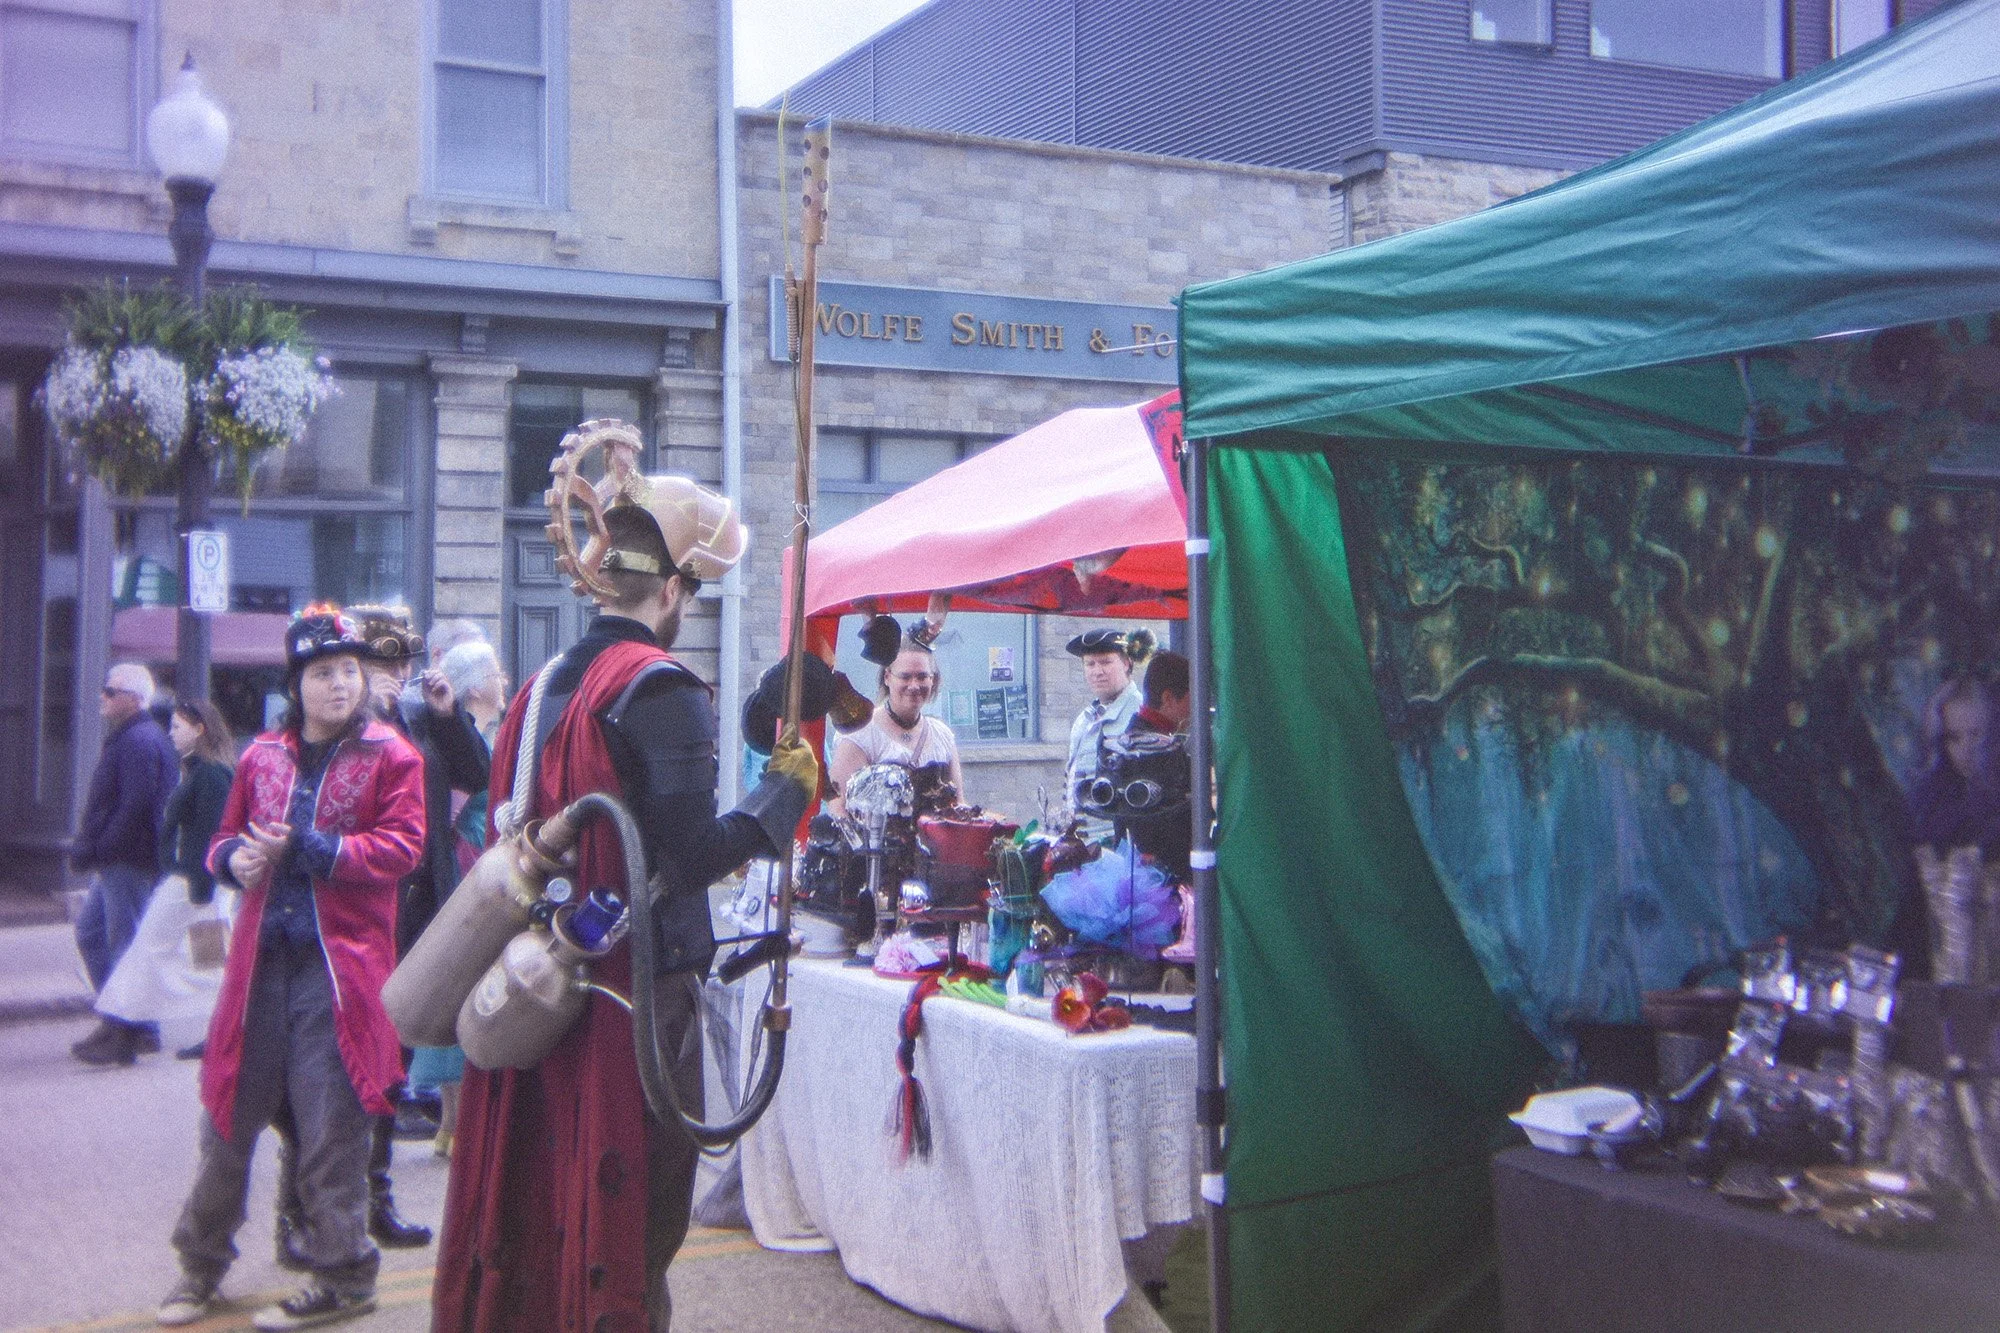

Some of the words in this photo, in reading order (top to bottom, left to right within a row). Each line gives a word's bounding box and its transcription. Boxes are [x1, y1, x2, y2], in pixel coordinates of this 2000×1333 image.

[951, 312, 1065, 350] SMITH
[1089, 327, 1111, 353] &
[1132, 323, 1173, 357] FO
